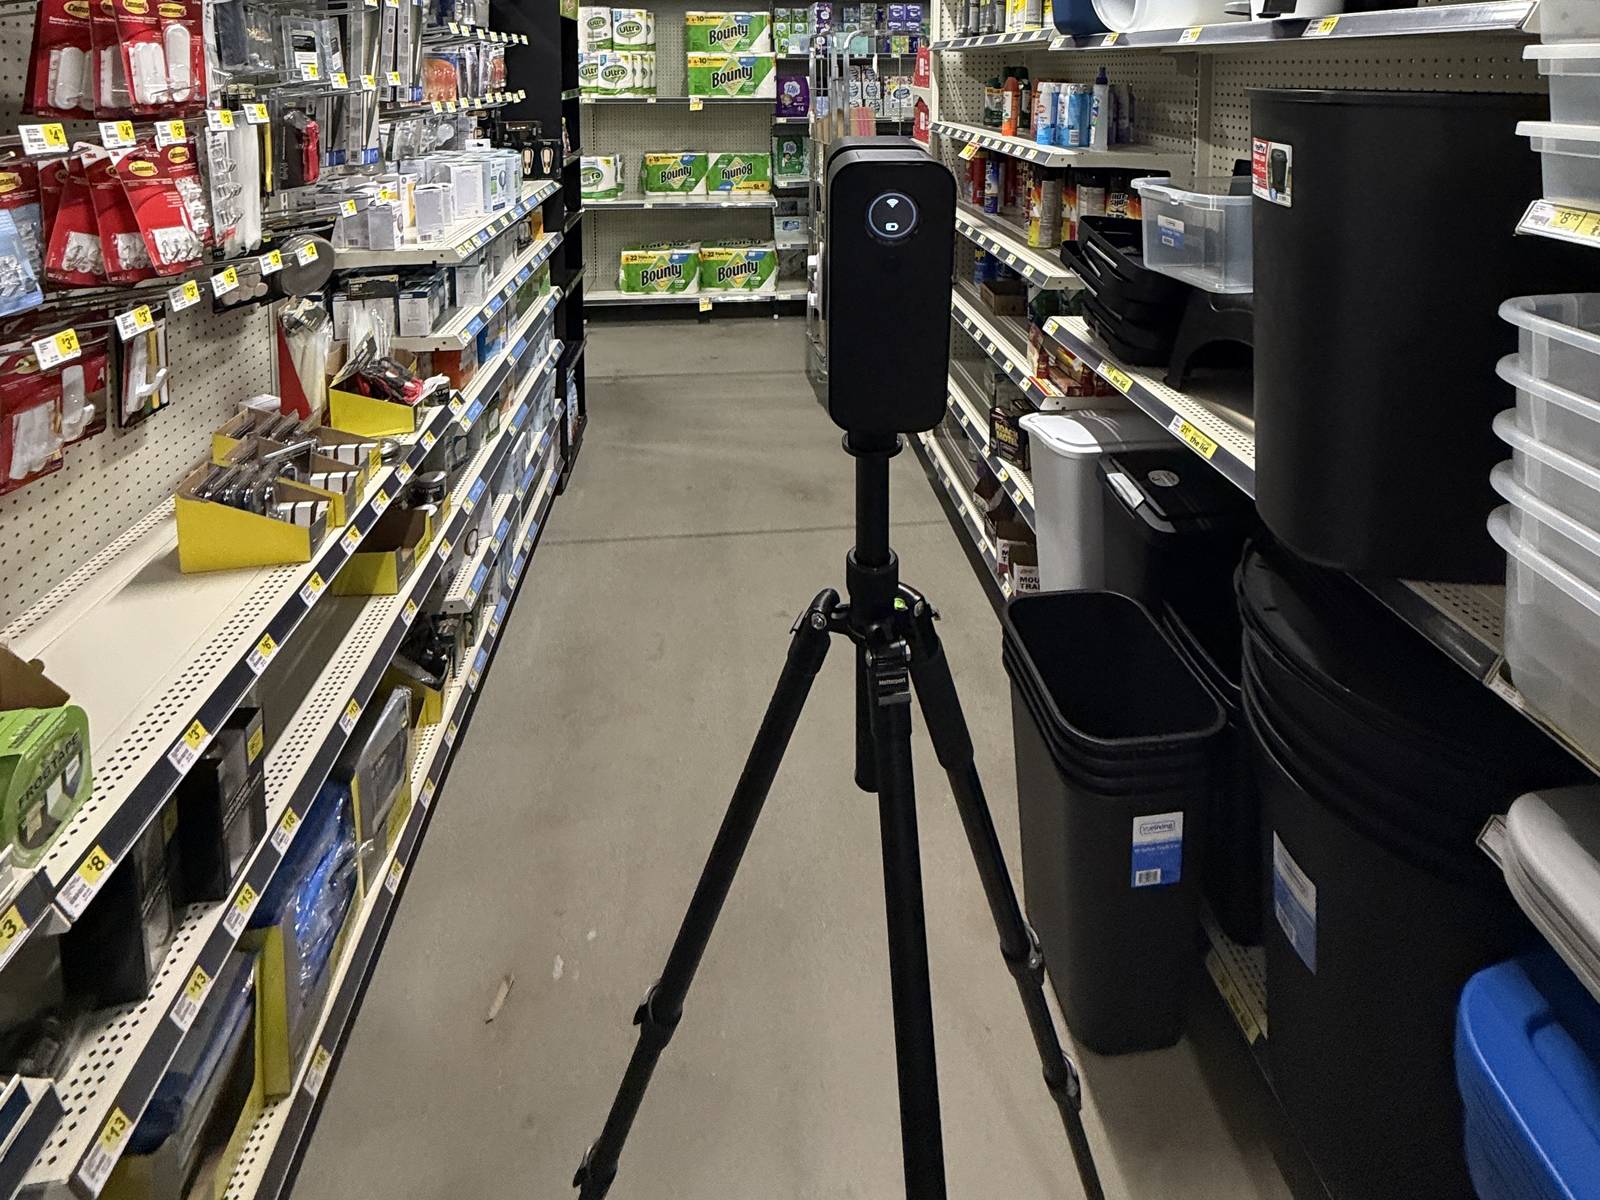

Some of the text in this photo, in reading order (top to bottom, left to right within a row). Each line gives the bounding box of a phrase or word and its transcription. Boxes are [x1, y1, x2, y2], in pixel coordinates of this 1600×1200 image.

[619, 25, 640, 33] Ultra
[709, 24, 748, 45] Bounty
[582, 67, 598, 76] Ultr
[604, 68, 625, 77] Ultra
[712, 66, 752, 88] Bounty
[660, 167, 692, 184] Bounty
[722, 163, 753, 180] Bounty
[226, 272, 235, 283] $5
[641, 264, 682, 286] Bounty
[718, 261, 758, 282] Bounty
[878, 677, 906, 686] Matterport
[87, 855, 105, 872] $8
[239, 888, 253, 906] $13
[191, 973, 206, 992] $13
[105, 1116, 127, 1142] $13
